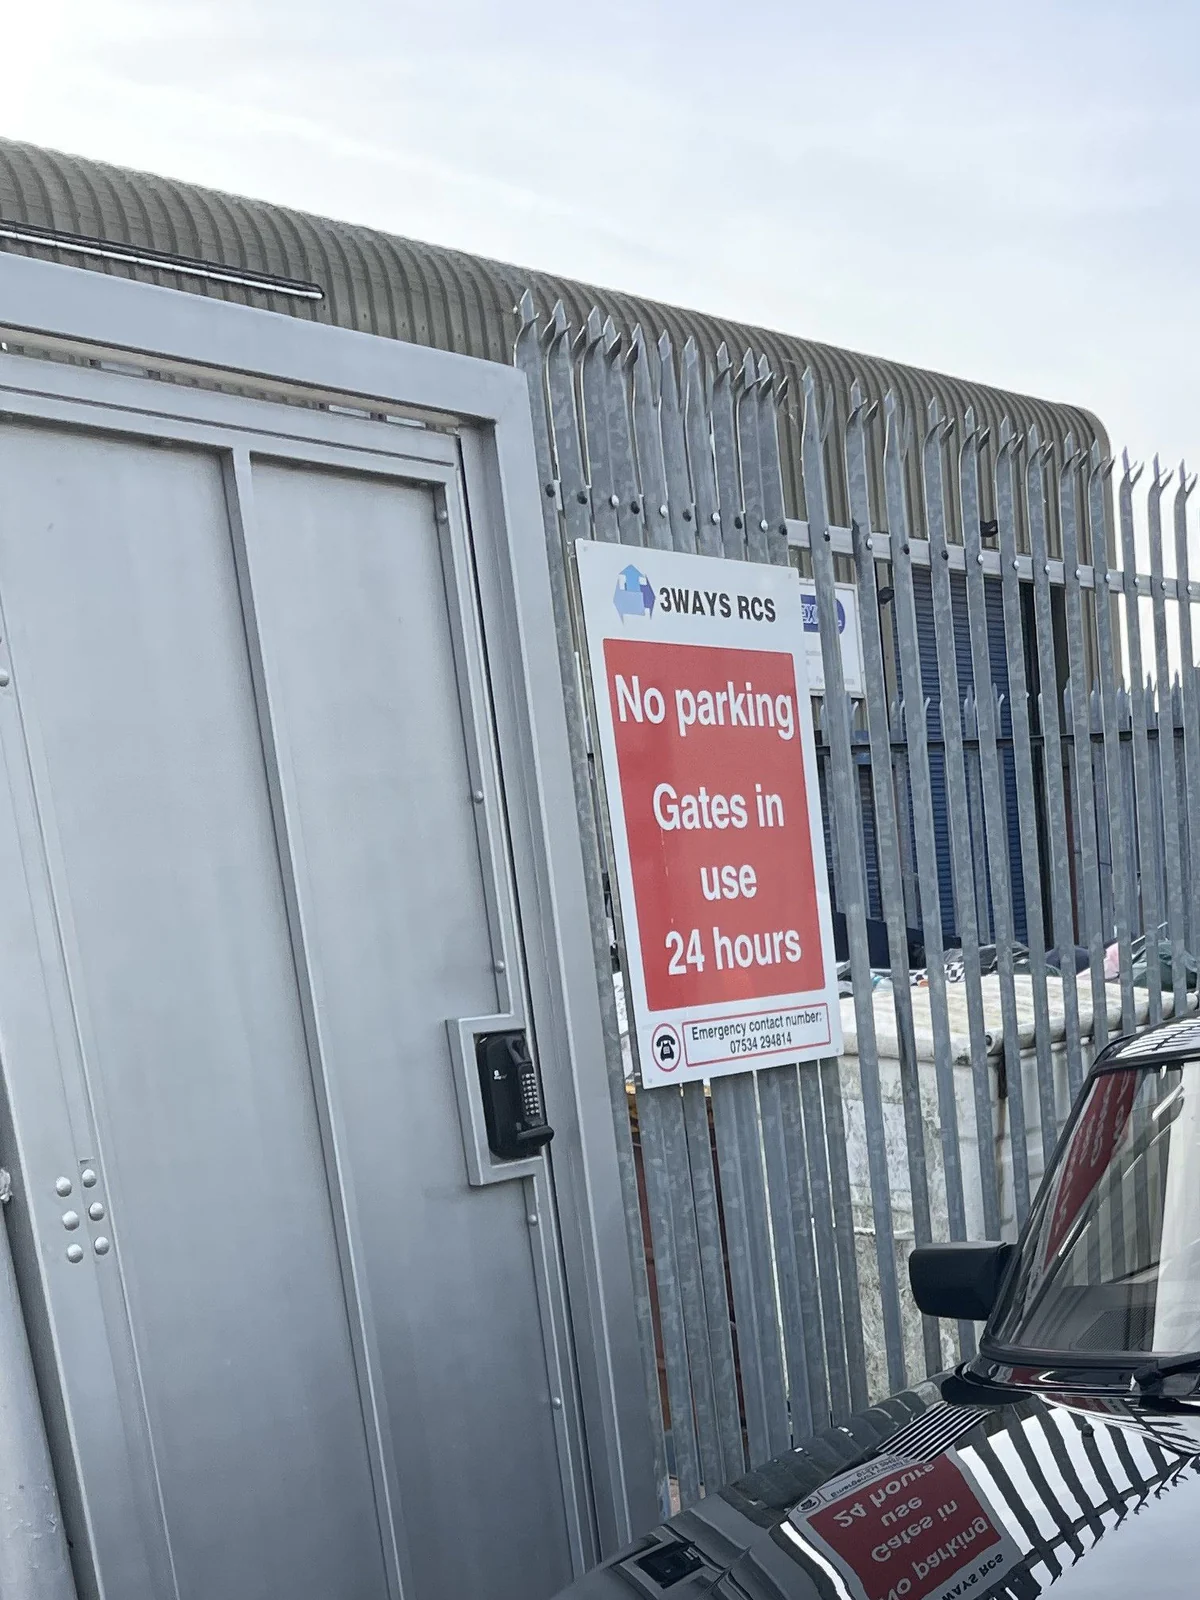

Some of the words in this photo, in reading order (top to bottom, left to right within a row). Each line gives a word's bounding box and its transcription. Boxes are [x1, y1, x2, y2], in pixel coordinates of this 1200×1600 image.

[659, 587, 731, 619] 3WAYS
[739, 595, 776, 623] RCS
[614, 674, 666, 724] No
[676, 682, 795, 741] parking
[653, 783, 748, 831] Gates
[755, 785, 785, 828] in
[700, 863, 758, 902] use
[665, 931, 705, 976] 24
[714, 928, 802, 972] hours
[692, 1021, 747, 1041] Emergency
[749, 1017, 784, 1031] contact
[785, 1011, 822, 1026] number:
[729, 1036, 758, 1054] 07534
[760, 1032, 792, 1049] 294814
